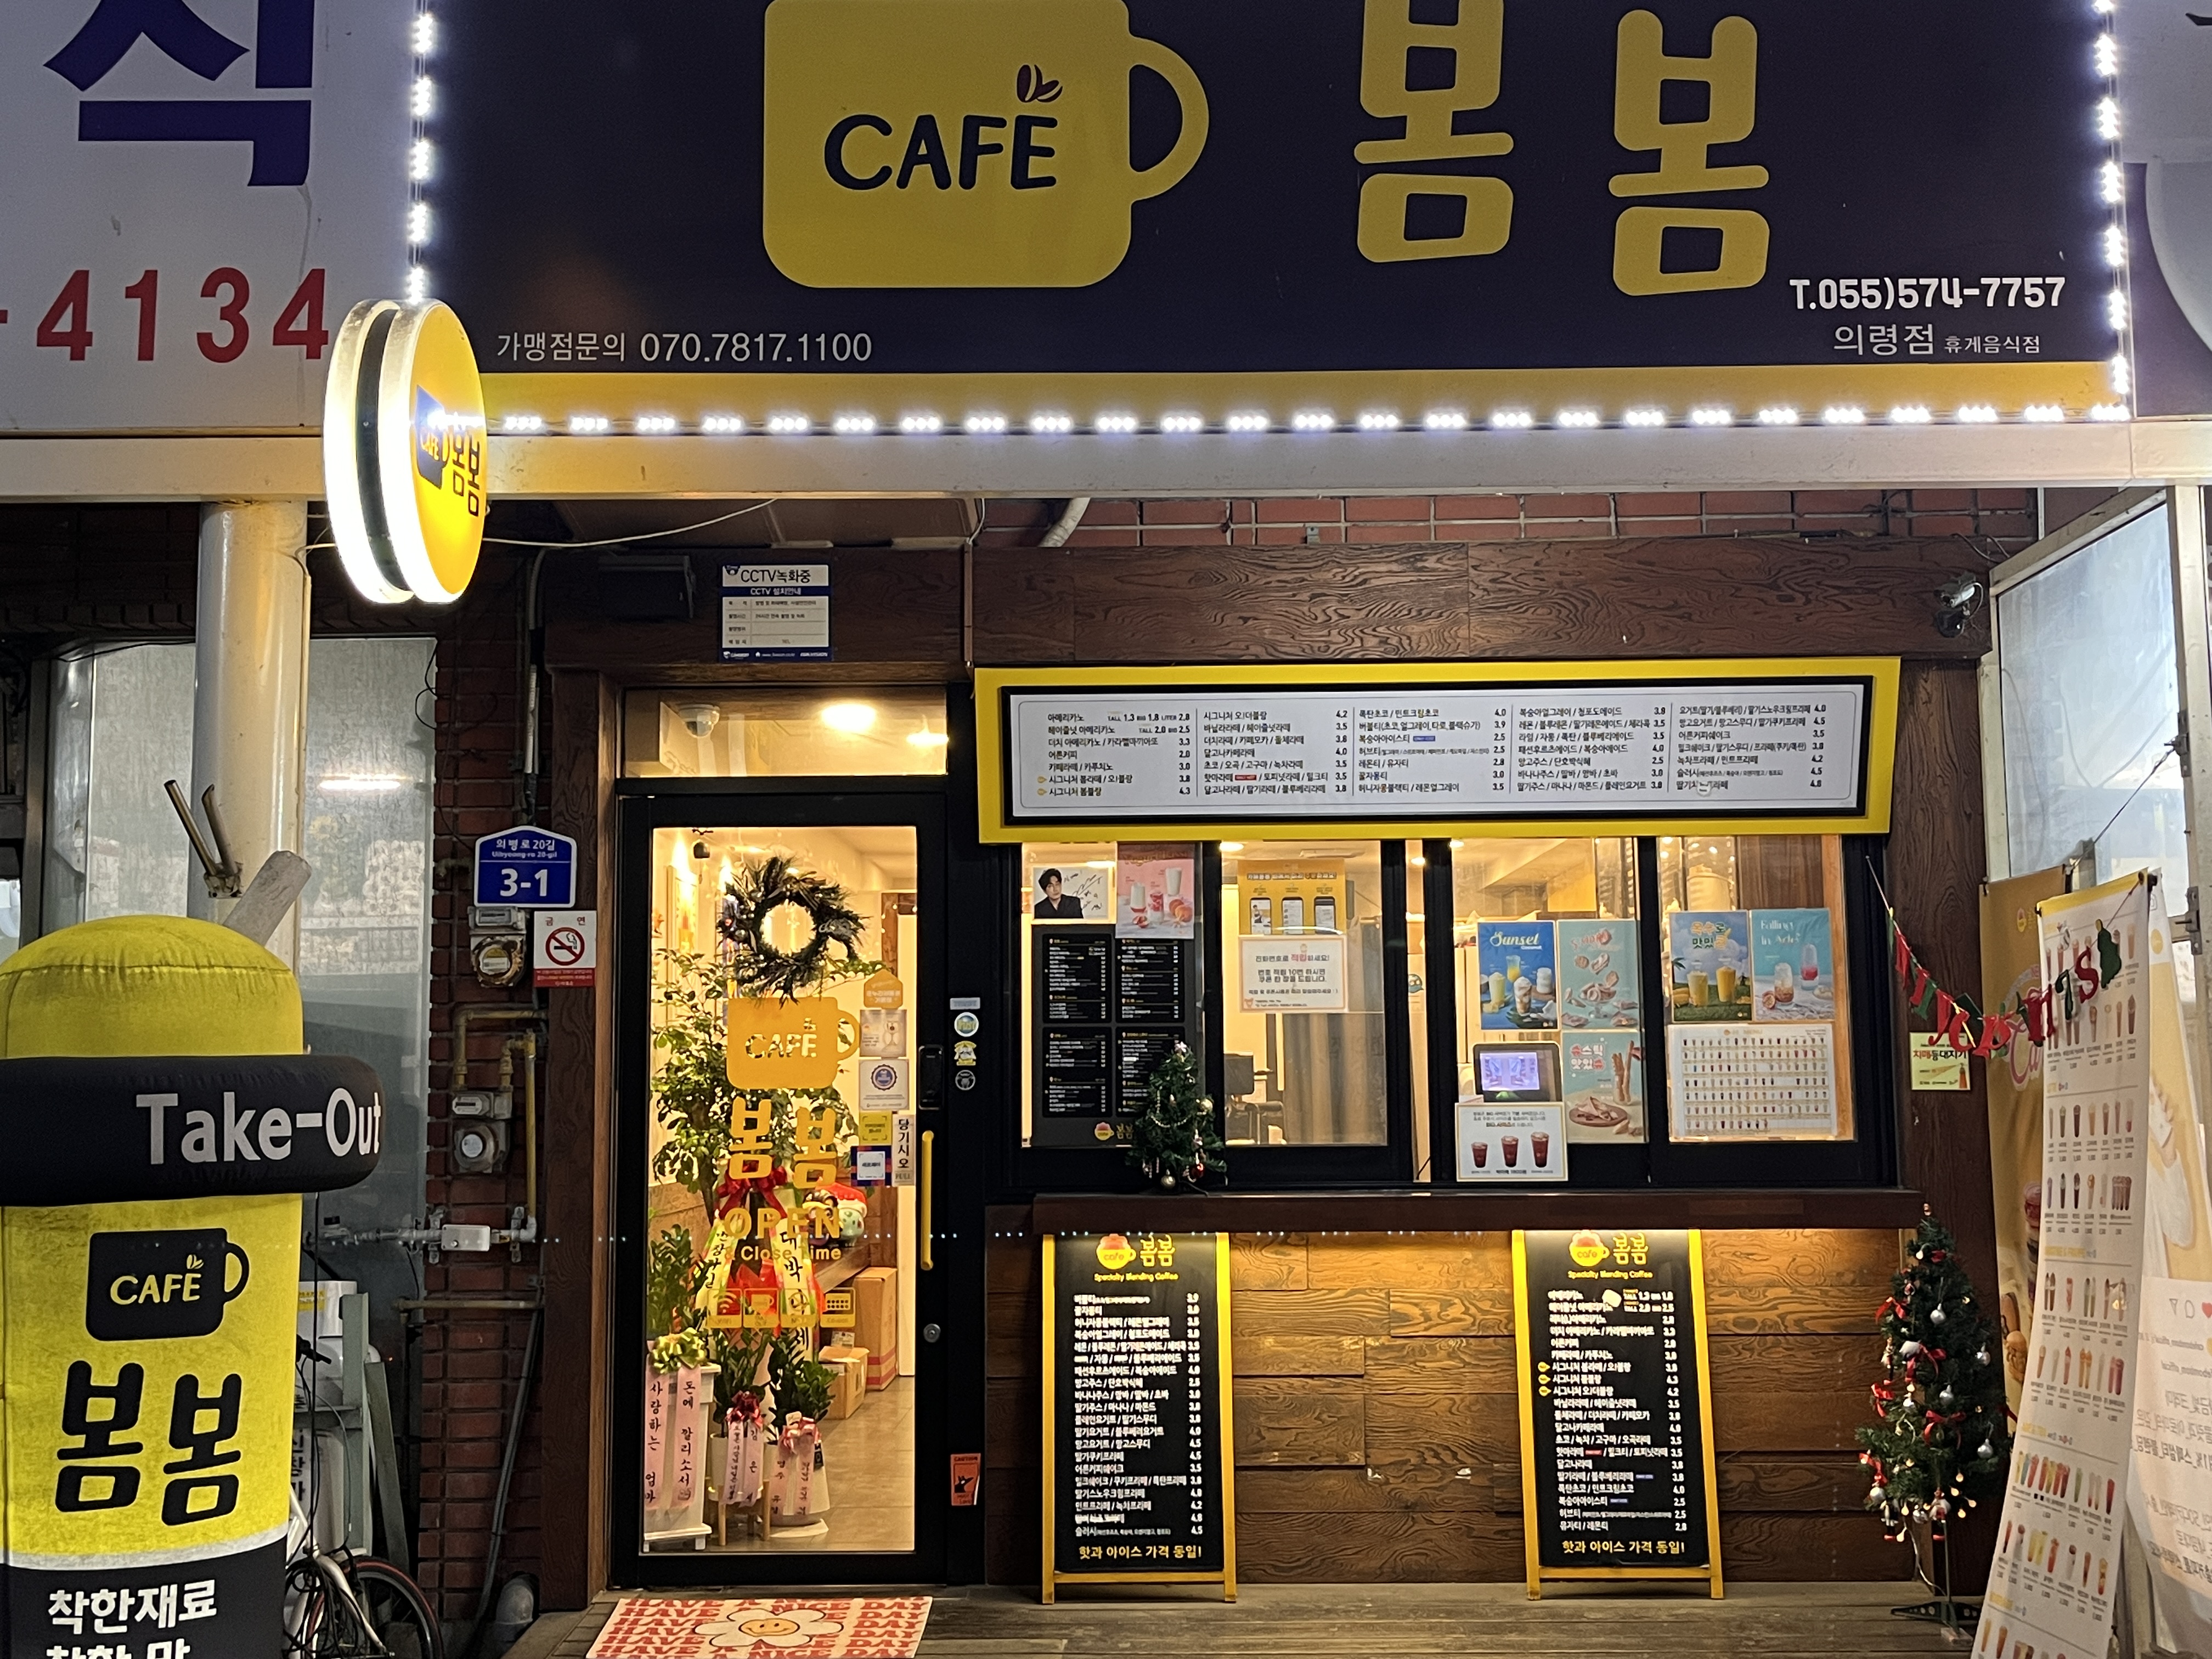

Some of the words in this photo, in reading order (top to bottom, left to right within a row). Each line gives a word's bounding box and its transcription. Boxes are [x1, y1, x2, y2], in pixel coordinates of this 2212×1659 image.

[1790, 277, 2066, 310] T.055)574-7757
[497, 332, 625, 362] 가맹점문의
[640, 332, 872, 362] 070.7817.1100
[1834, 323, 1934, 356] 의령점
[1944, 335, 2040, 353] 휴게음식점
[741, 569, 811, 583] CCTV녹화중
[1048, 713, 1084, 723] 아메리카노
[1065, 738, 1101, 747] 아메리카노
[500, 868, 548, 896] 3-1
[745, 1033, 817, 1059] CAFE
[136, 1088, 381, 1165] Take-Out
[898, 1119, 909, 1168] 당기시오
[724, 1207, 840, 1240] OPEN
[741, 1245, 792, 1260] Close
[110, 1273, 201, 1305] CAFE
[682, 1381, 696, 1409] 돈에
[55, 1361, 242, 1526] 봄봄
[678, 1427, 693, 1487] 깔리소서
[1079, 1546, 1102, 1559] 핫과
[1107, 1546, 1142, 1558] 아이스
[1146, 1545, 1169, 1558] 가격
[1562, 1542, 1585, 1554] 핫과
[1590, 1541, 1625, 1553] 아이스
[1629, 1541, 1652, 1554] 가격
[48, 1579, 217, 1635] 착한재료
[619, 1609, 721, 1617] HAVE
[860, 1602, 928, 1610] DAY
[602, 1636, 706, 1644] HAVE
[607, 1627, 696, 1635] HAV
[853, 1620, 924, 1628] DAY
[841, 1649, 915, 1657] DAY
[845, 1639, 918, 1647] DAY
